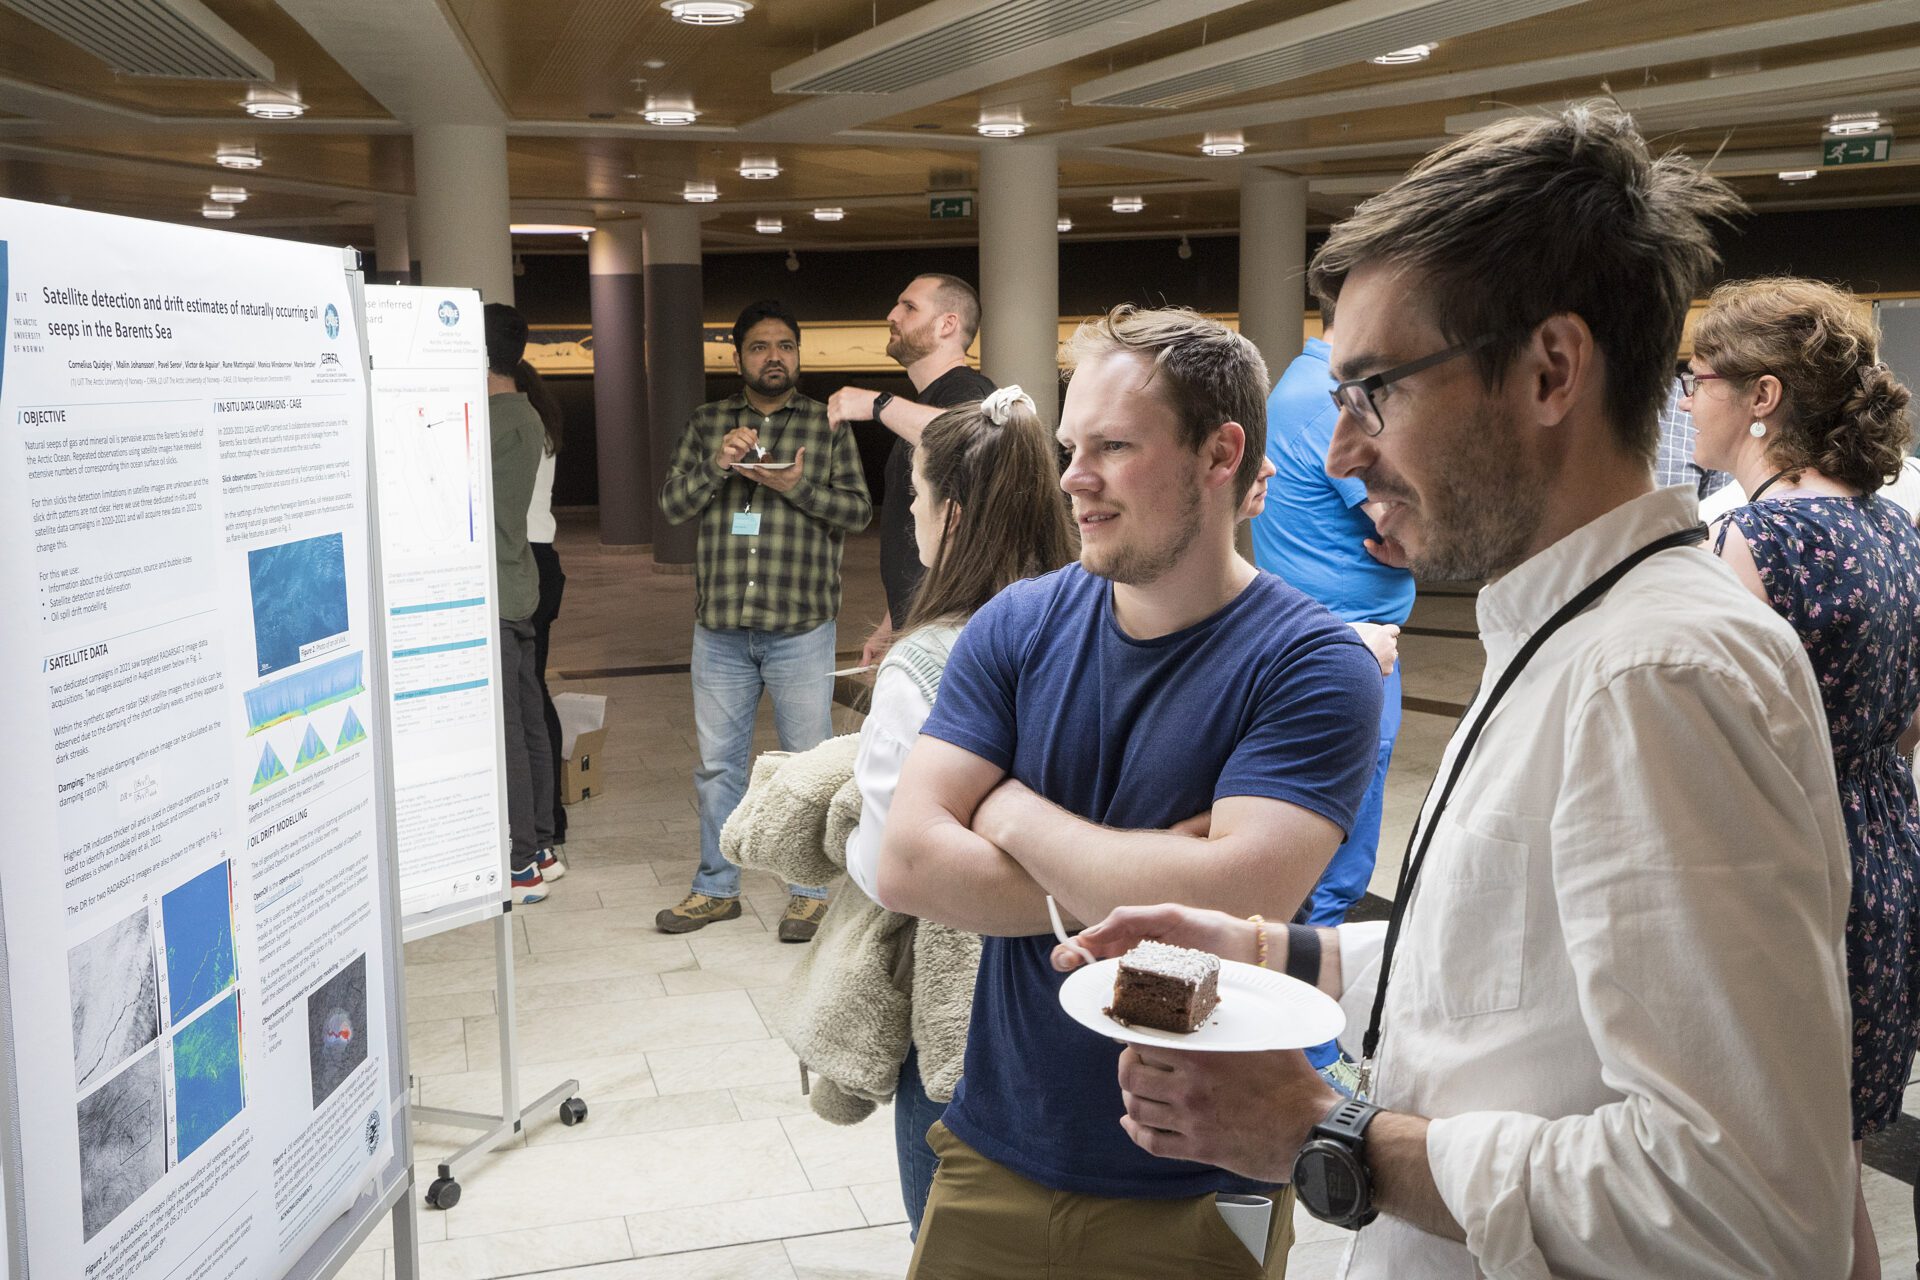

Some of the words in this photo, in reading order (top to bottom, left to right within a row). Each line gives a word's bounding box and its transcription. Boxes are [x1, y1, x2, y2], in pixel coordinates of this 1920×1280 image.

[43, 287, 88, 306] Satellite
[92, 291, 141, 309] detection
[144, 295, 162, 310] and
[164, 296, 184, 311] drift
[186, 299, 228, 314] estimates
[230, 300, 239, 314] of
[241, 303, 273, 319] naturally
[276, 306, 308, 321] occurring
[310, 306, 319, 319] oil
[379, 299, 412, 310] inferred
[48, 323, 80, 340] seeps
[81, 320, 92, 336] in
[95, 320, 112, 337] the
[115, 322, 154, 338] Barents
[155, 324, 173, 339] Sea
[68, 360, 92, 368] Cornelius
[218, 402, 240, 412] IN-SITU
[241, 401, 256, 411] DATA
[256, 400, 286, 410] CAMPAIGNS
[289, 399, 302, 408] CAGE
[23, 410, 66, 426] OBJECTIVE
[40, 572, 48, 581] For
[50, 569, 60, 579] this
[50, 596, 71, 608] Satellite
[72, 591, 95, 602] detection
[96, 587, 105, 597] and
[106, 583, 132, 594] delineation
[50, 611, 59, 621] Oil
[60, 608, 70, 621] spill
[71, 606, 82, 616] drift
[83, 601, 107, 613] modelling
[49, 649, 88, 670] SATELLITE
[90, 644, 109, 659] DATA
[59, 778, 86, 793] Damping:
[251, 835, 260, 847] OIL
[261, 825, 276, 841] DRIFT
[277, 809, 308, 832] MODELLING
